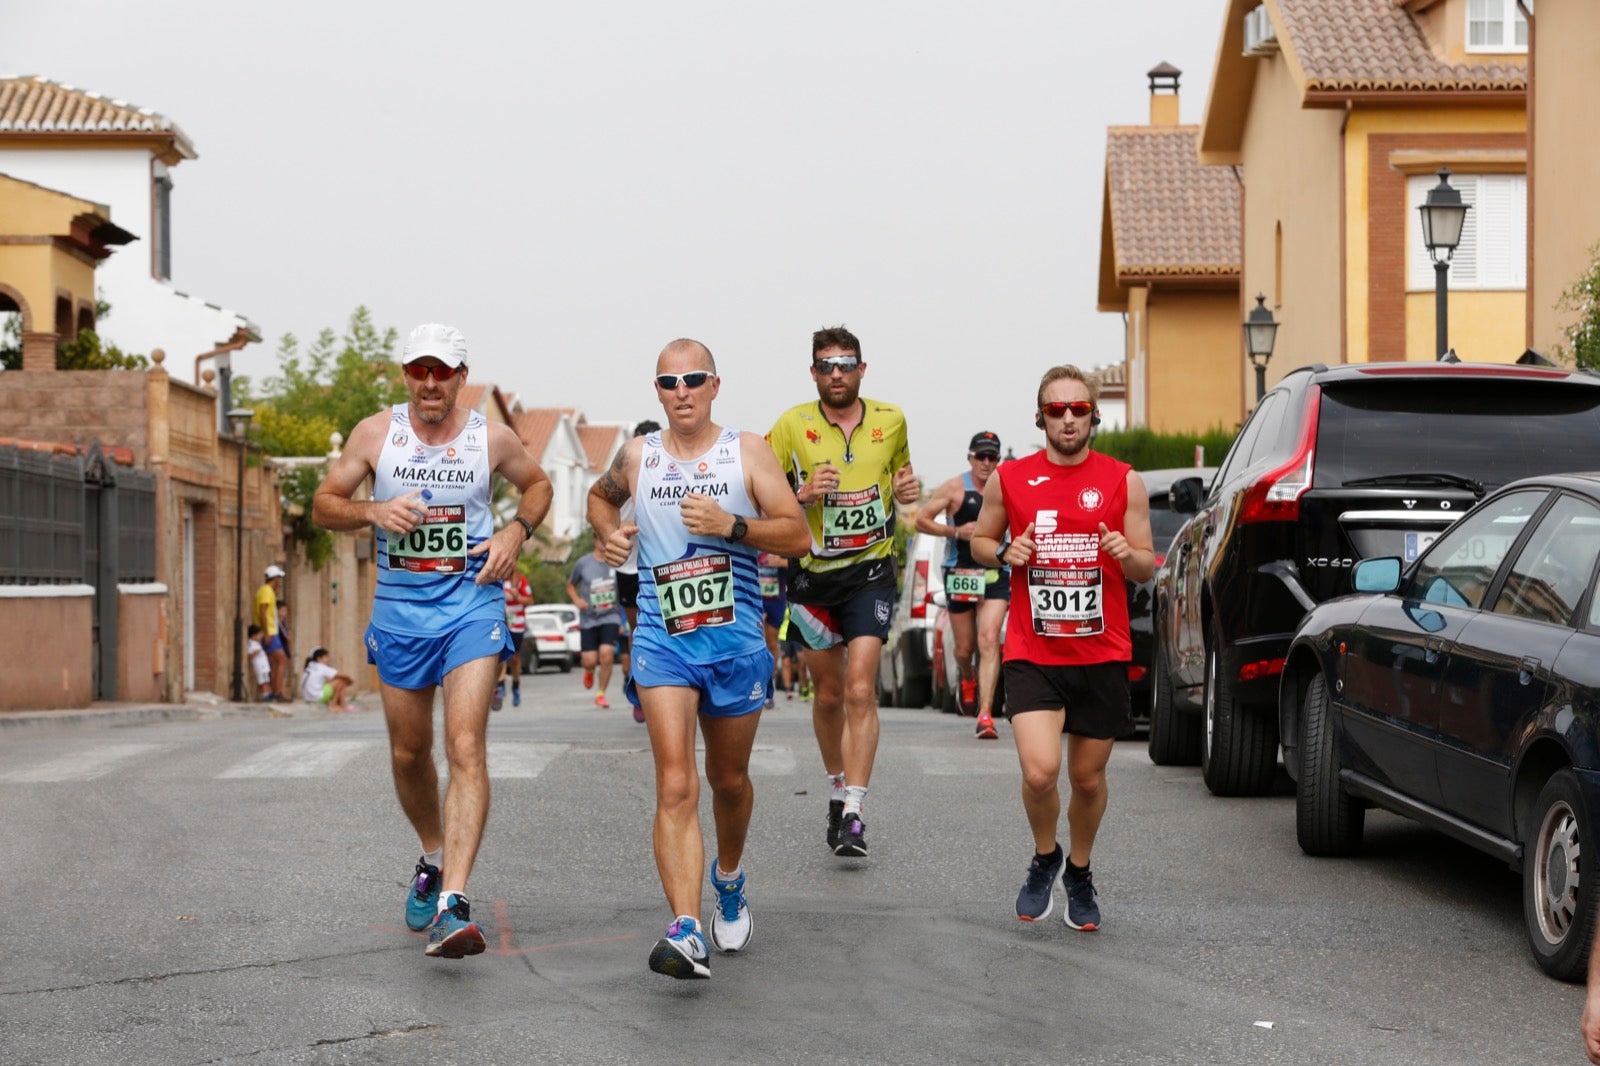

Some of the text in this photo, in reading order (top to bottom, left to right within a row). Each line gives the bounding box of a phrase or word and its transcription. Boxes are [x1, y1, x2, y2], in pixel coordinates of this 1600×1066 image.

[393, 466, 475, 483] MARACENA
[650, 482, 729, 500] MARACENA
[437, 508, 444, 516] DE
[444, 507, 461, 516] FONDO
[834, 506, 878, 531] 428
[1035, 510, 1058, 534] 5
[1035, 533, 1100, 544] CARRERA
[1035, 543, 1099, 552] UNIVERSIDAD
[669, 563, 684, 573] GRAN
[683, 560, 703, 571] PREMIO
[709, 556, 726, 566] FONDO
[1045, 571, 1058, 579] GRAN
[1059, 571, 1077, 579] PREMIO
[1077, 571, 1083, 579] DE
[953, 577, 978, 591] 668
[663, 576, 729, 612] 1067
[1037, 589, 1097, 612] 3012
